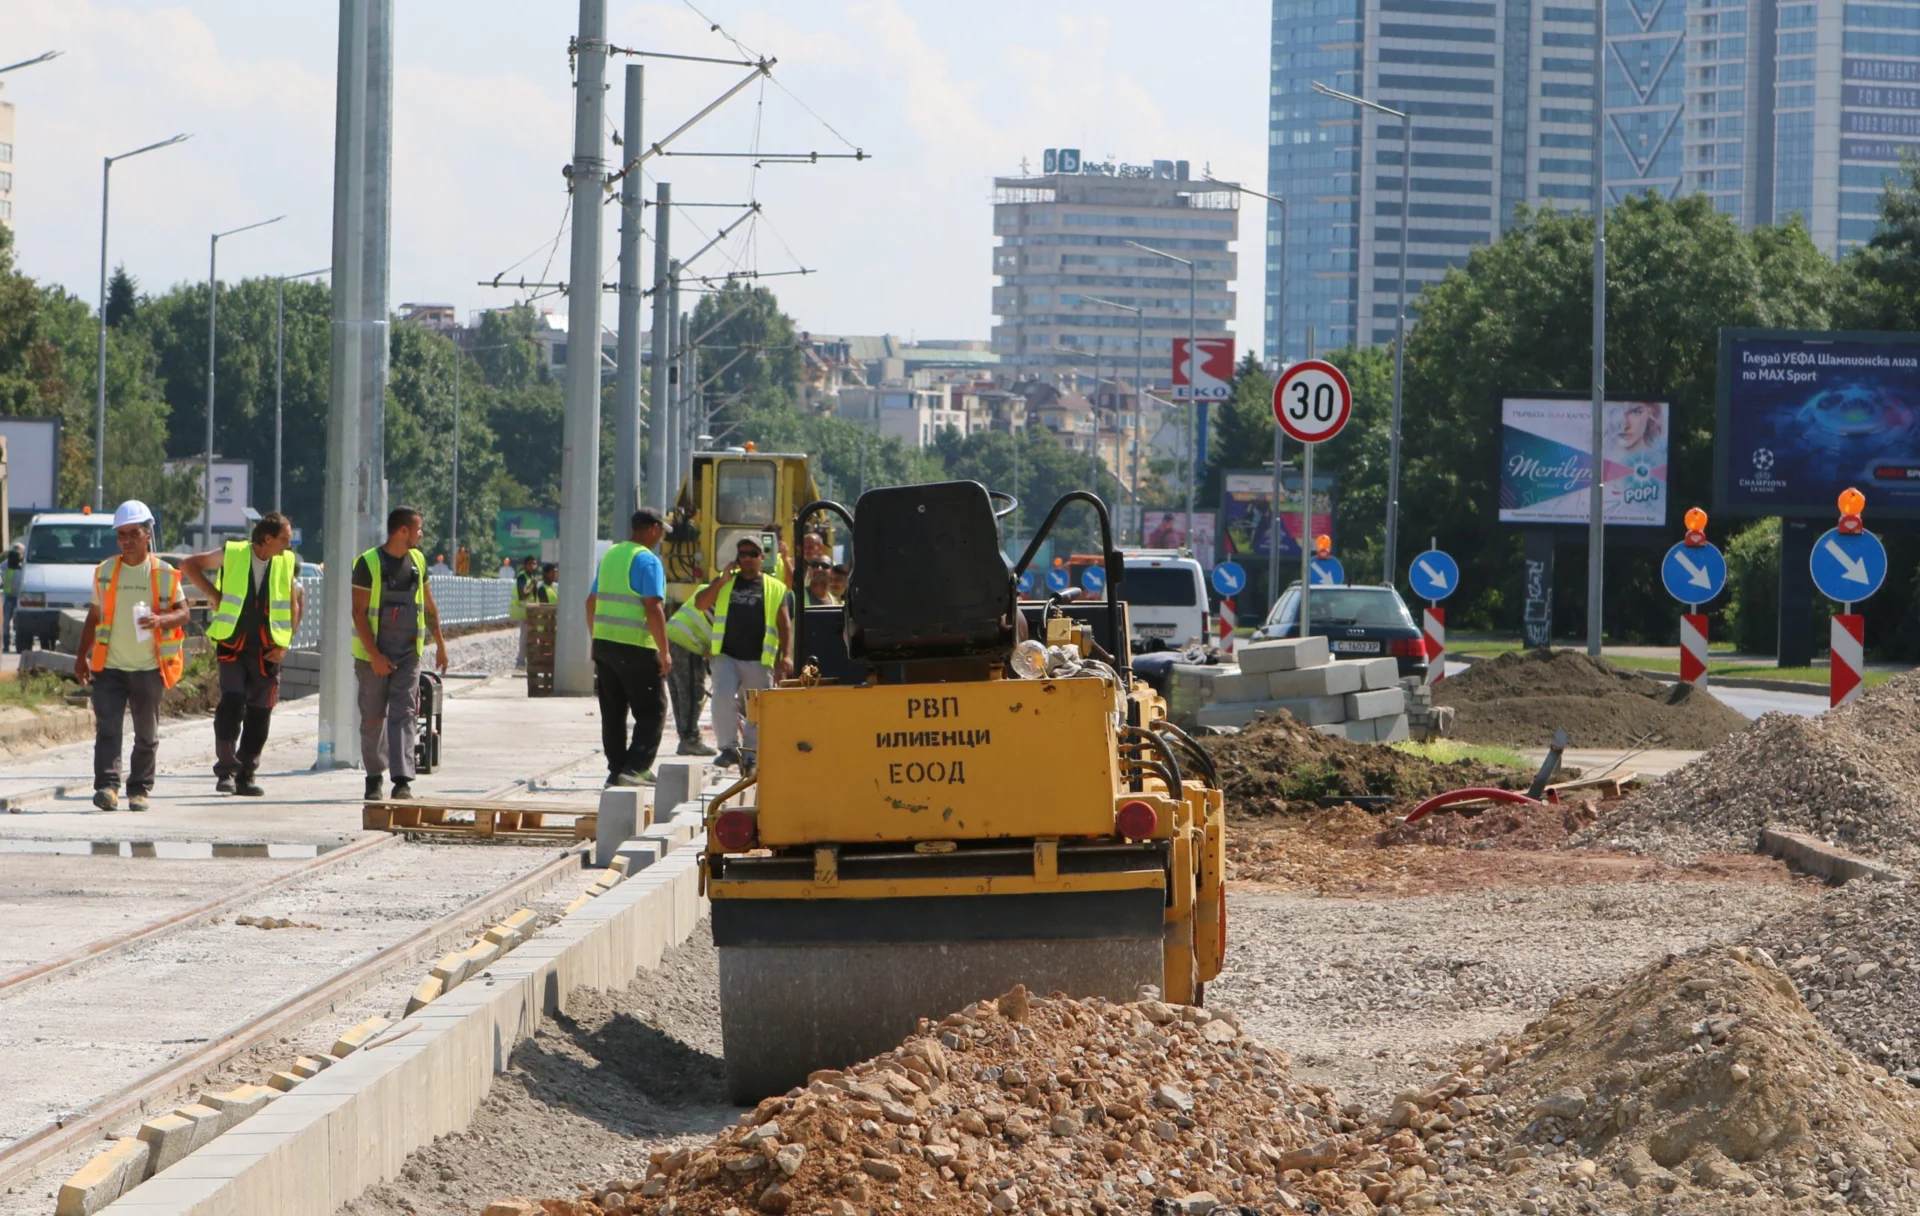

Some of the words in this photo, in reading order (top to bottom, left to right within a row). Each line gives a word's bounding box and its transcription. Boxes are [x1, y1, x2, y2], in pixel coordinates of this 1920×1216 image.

[1852, 61, 1920, 81] APARTMENT
[1858, 88, 1881, 106] FOR
[1887, 90, 1917, 107] SALE
[1743, 351, 1781, 367] Гледай
[1783, 352, 1816, 366] УЕФА
[1817, 353, 1890, 366] Шампионска
[1892, 357, 1918, 368] лига
[1758, 369, 1785, 381] MAX
[1787, 370, 1817, 384] Sport
[1178, 387, 1227, 397] EKO
[1289, 381, 1334, 422] 30
[1738, 478, 1787, 488] CHAMPIONS
[1624, 486, 1658, 504] POP!
[907, 696, 959, 719] РВП
[876, 729, 991, 748] ИЛИЕНЦИ
[889, 761, 965, 785] ЕООД
